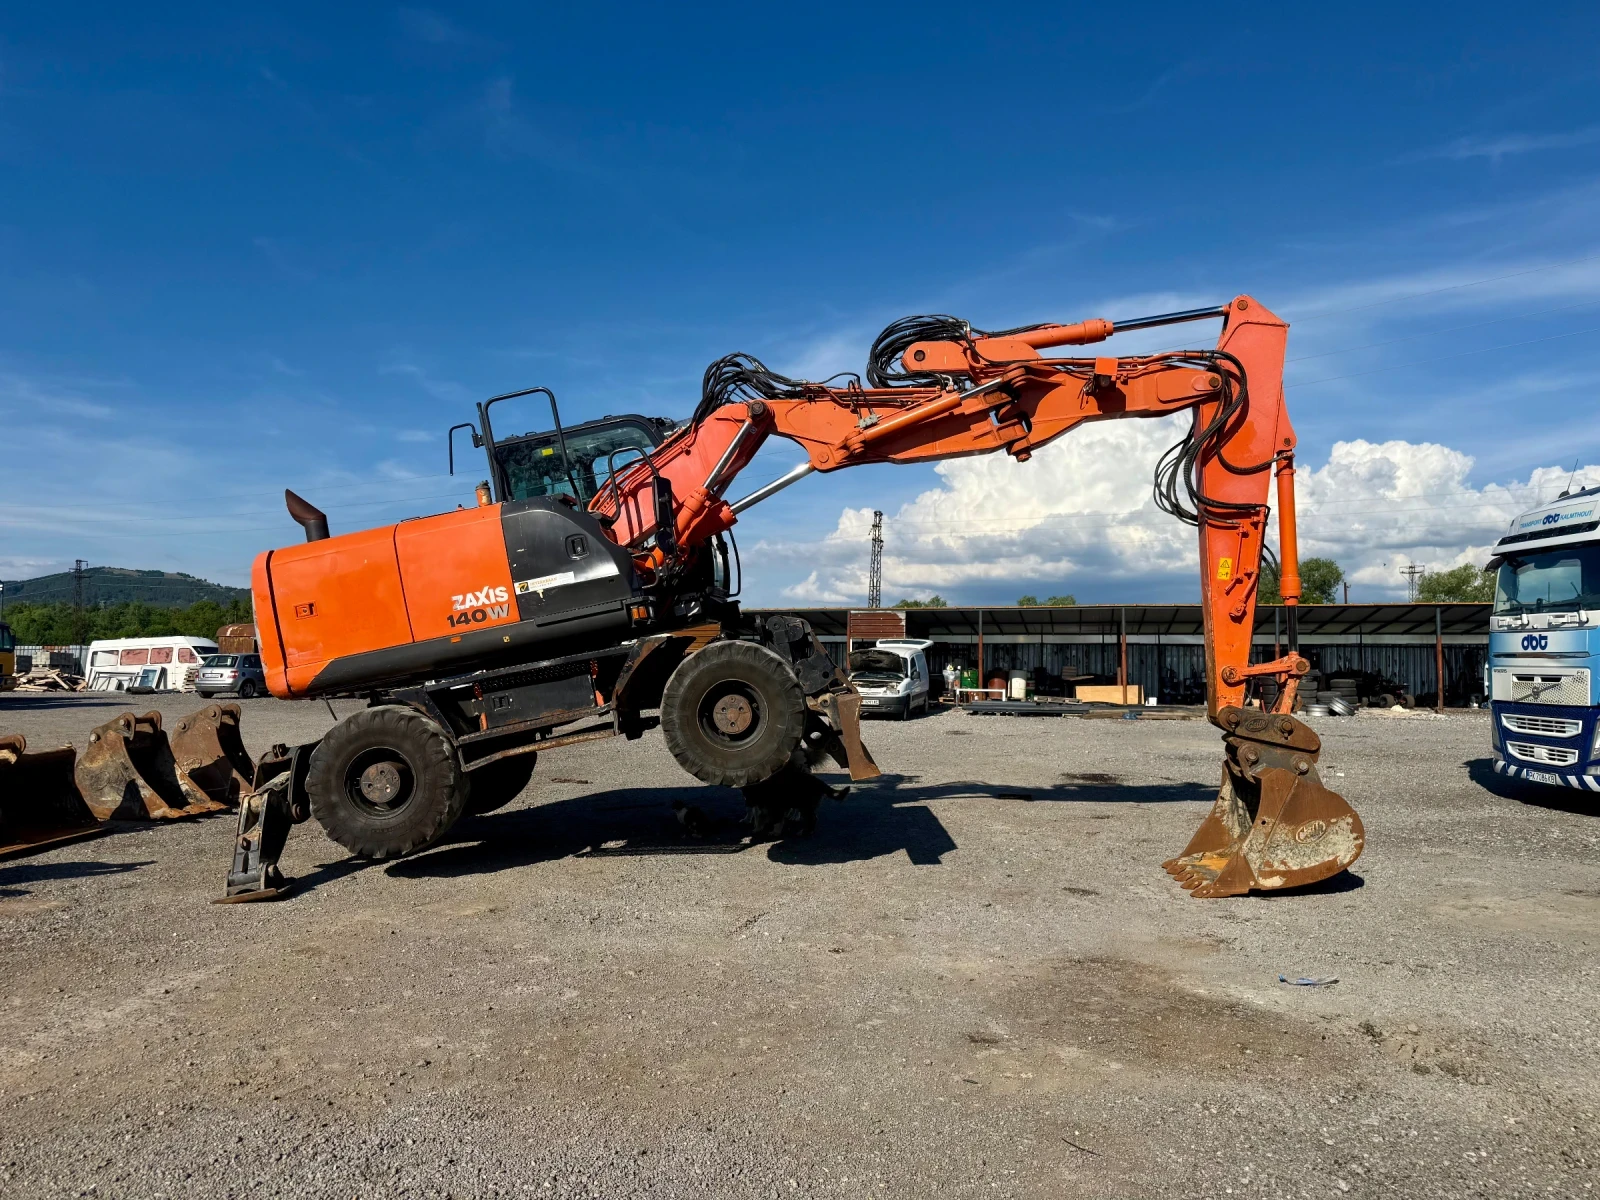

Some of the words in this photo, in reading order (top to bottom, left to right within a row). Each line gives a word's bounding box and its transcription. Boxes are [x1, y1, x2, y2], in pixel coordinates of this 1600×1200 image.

[1520, 518, 1542, 528] TRANSPORT
[1560, 510, 1593, 520] KALMTHOUT
[451, 585, 509, 611] ZAXIS
[446, 603, 510, 628] 140W
[1521, 634, 1548, 651] dbt
